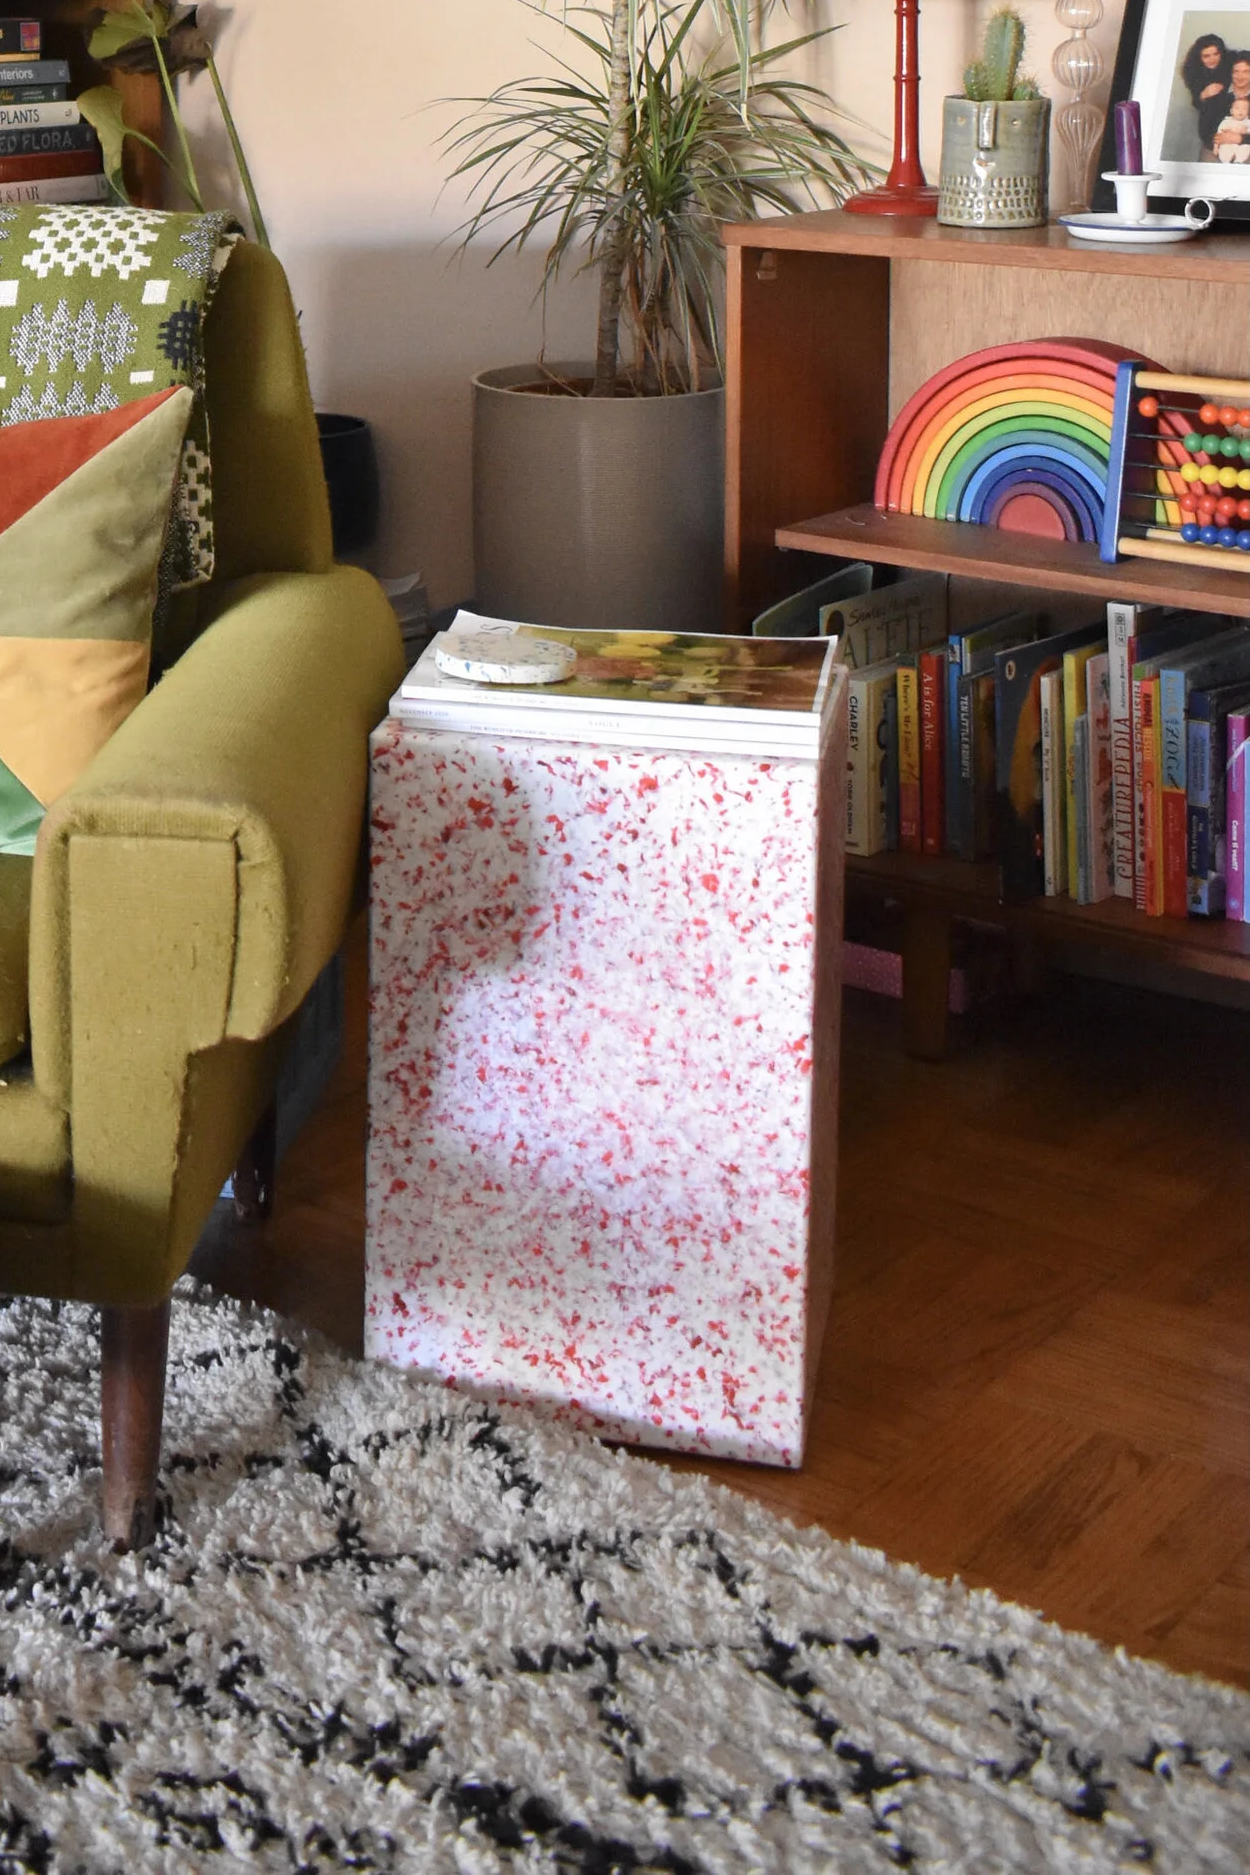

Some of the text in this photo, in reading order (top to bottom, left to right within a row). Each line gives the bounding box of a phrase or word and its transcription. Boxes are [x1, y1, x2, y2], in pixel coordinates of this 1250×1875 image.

[849, 695, 858, 752] CHARLEY
[922, 672, 935, 751] A is for Alice
[960, 712, 971, 742] LITTLE
[1113, 716, 1132, 880] CREATUREPEDIA
